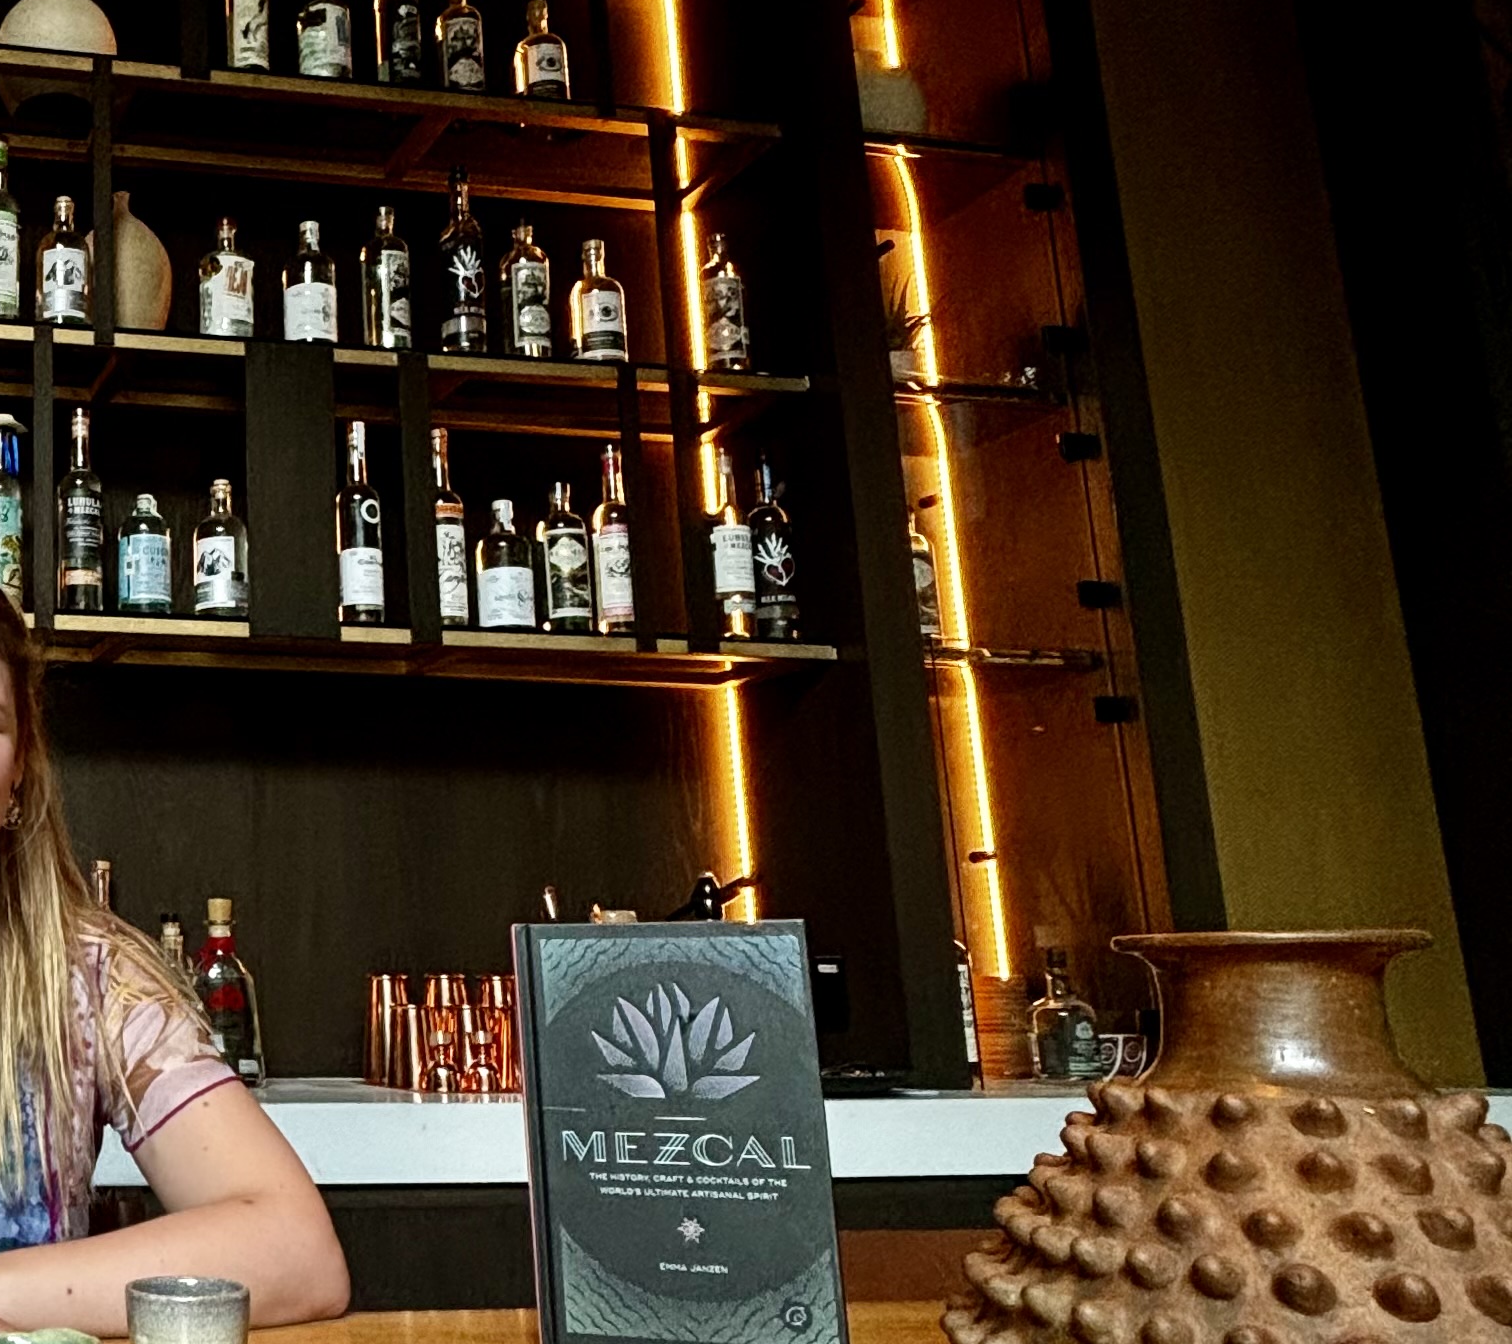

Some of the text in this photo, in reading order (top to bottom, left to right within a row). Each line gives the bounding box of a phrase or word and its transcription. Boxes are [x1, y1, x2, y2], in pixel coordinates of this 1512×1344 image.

[561, 1130, 812, 1170] MEZCAL
[589, 1172, 608, 1181] THE
[609, 1173, 651, 1183] HISTORY,
[653, 1174, 684, 1183] CRAFT
[696, 1176, 749, 1187] COCKTAILS
[751, 1178, 765, 1187] OF
[767, 1179, 787, 1187] THE
[600, 1187, 779, 1201] WORLD'S ULTIMATE ARTISANAL SPIRIT
[659, 1262, 728, 1274] EMMA JANZEN
